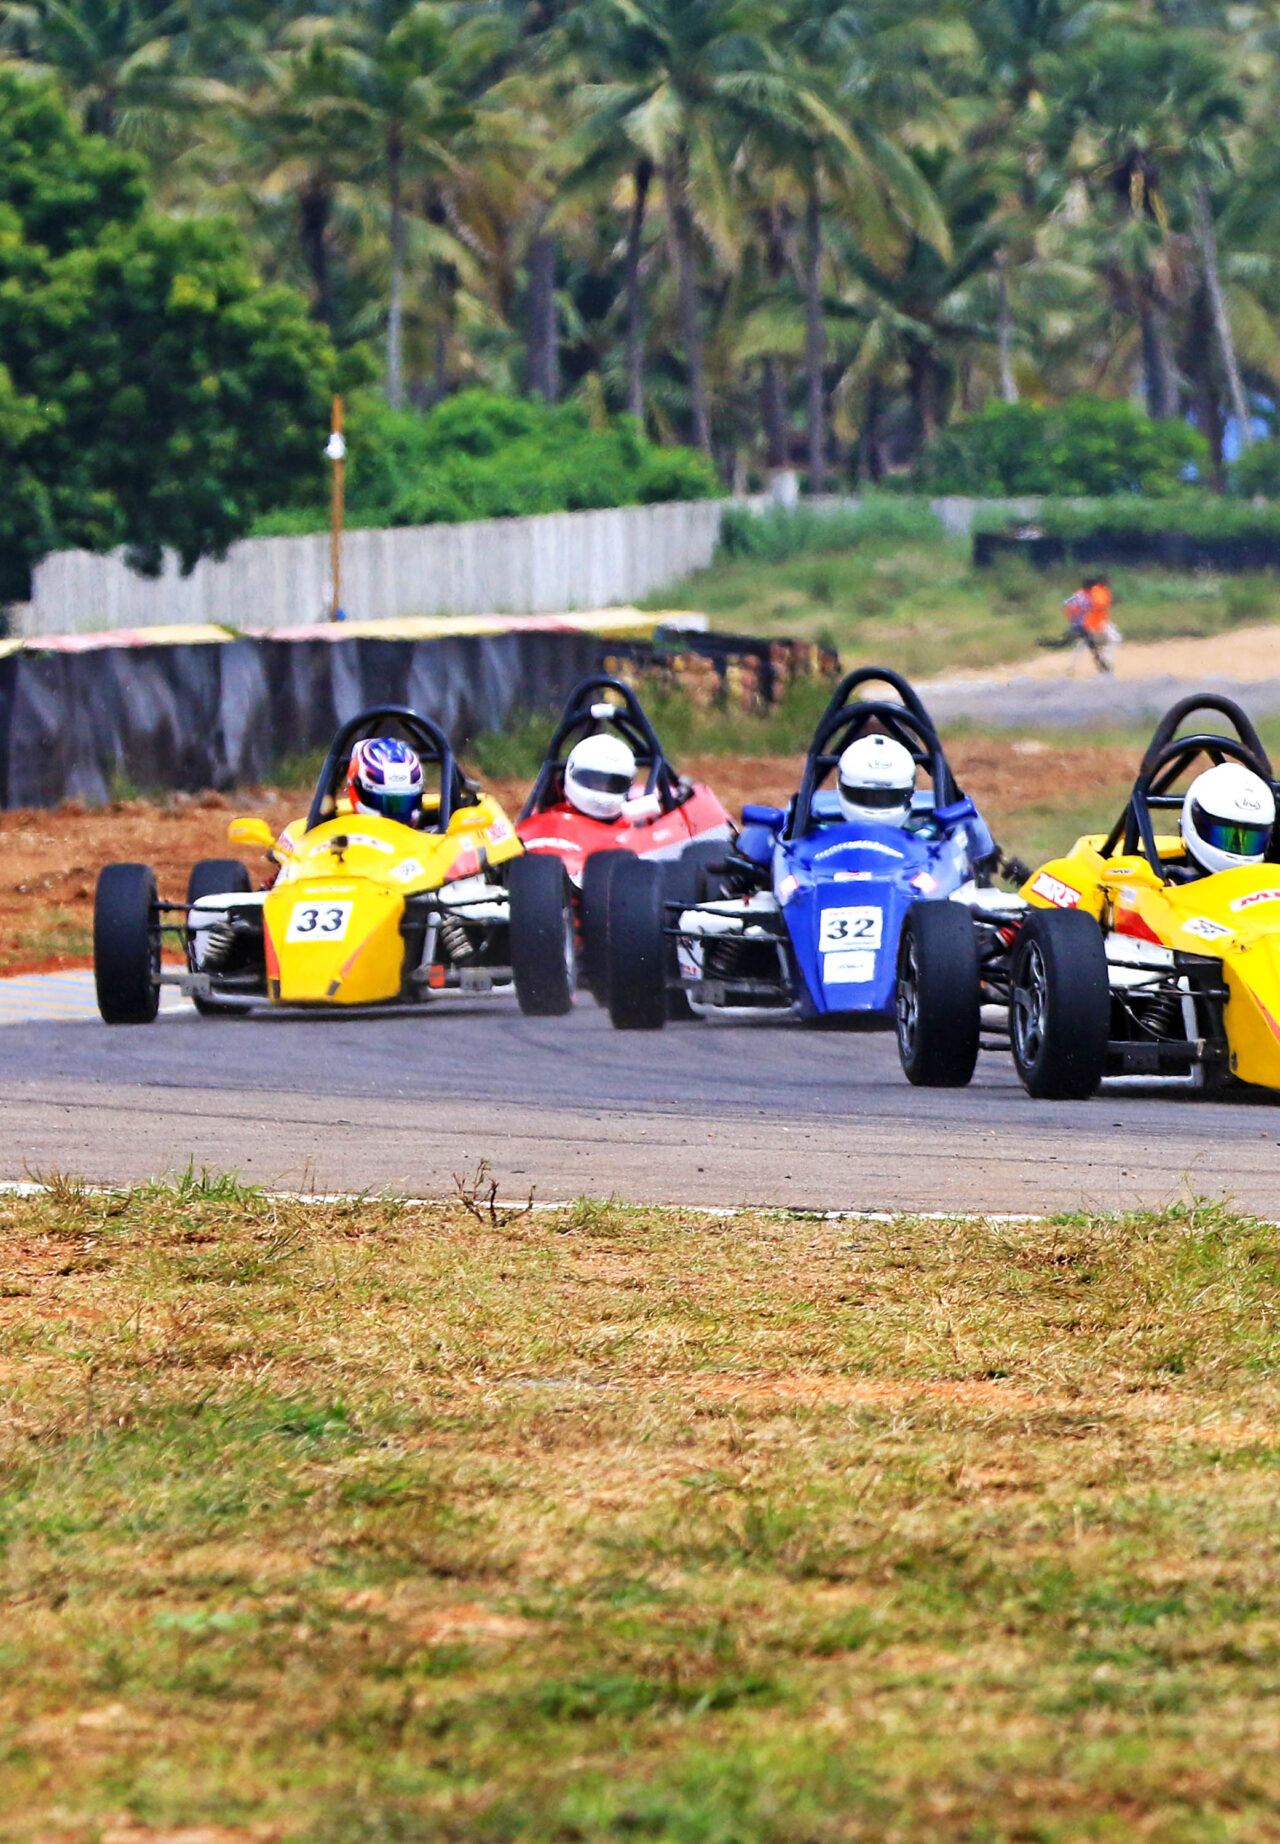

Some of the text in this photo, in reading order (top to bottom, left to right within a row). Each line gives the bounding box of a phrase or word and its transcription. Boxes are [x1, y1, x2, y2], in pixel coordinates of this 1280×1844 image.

[1032, 871, 1080, 908] MRF
[296, 908, 344, 932] 33
[826, 917, 876, 940] 32
